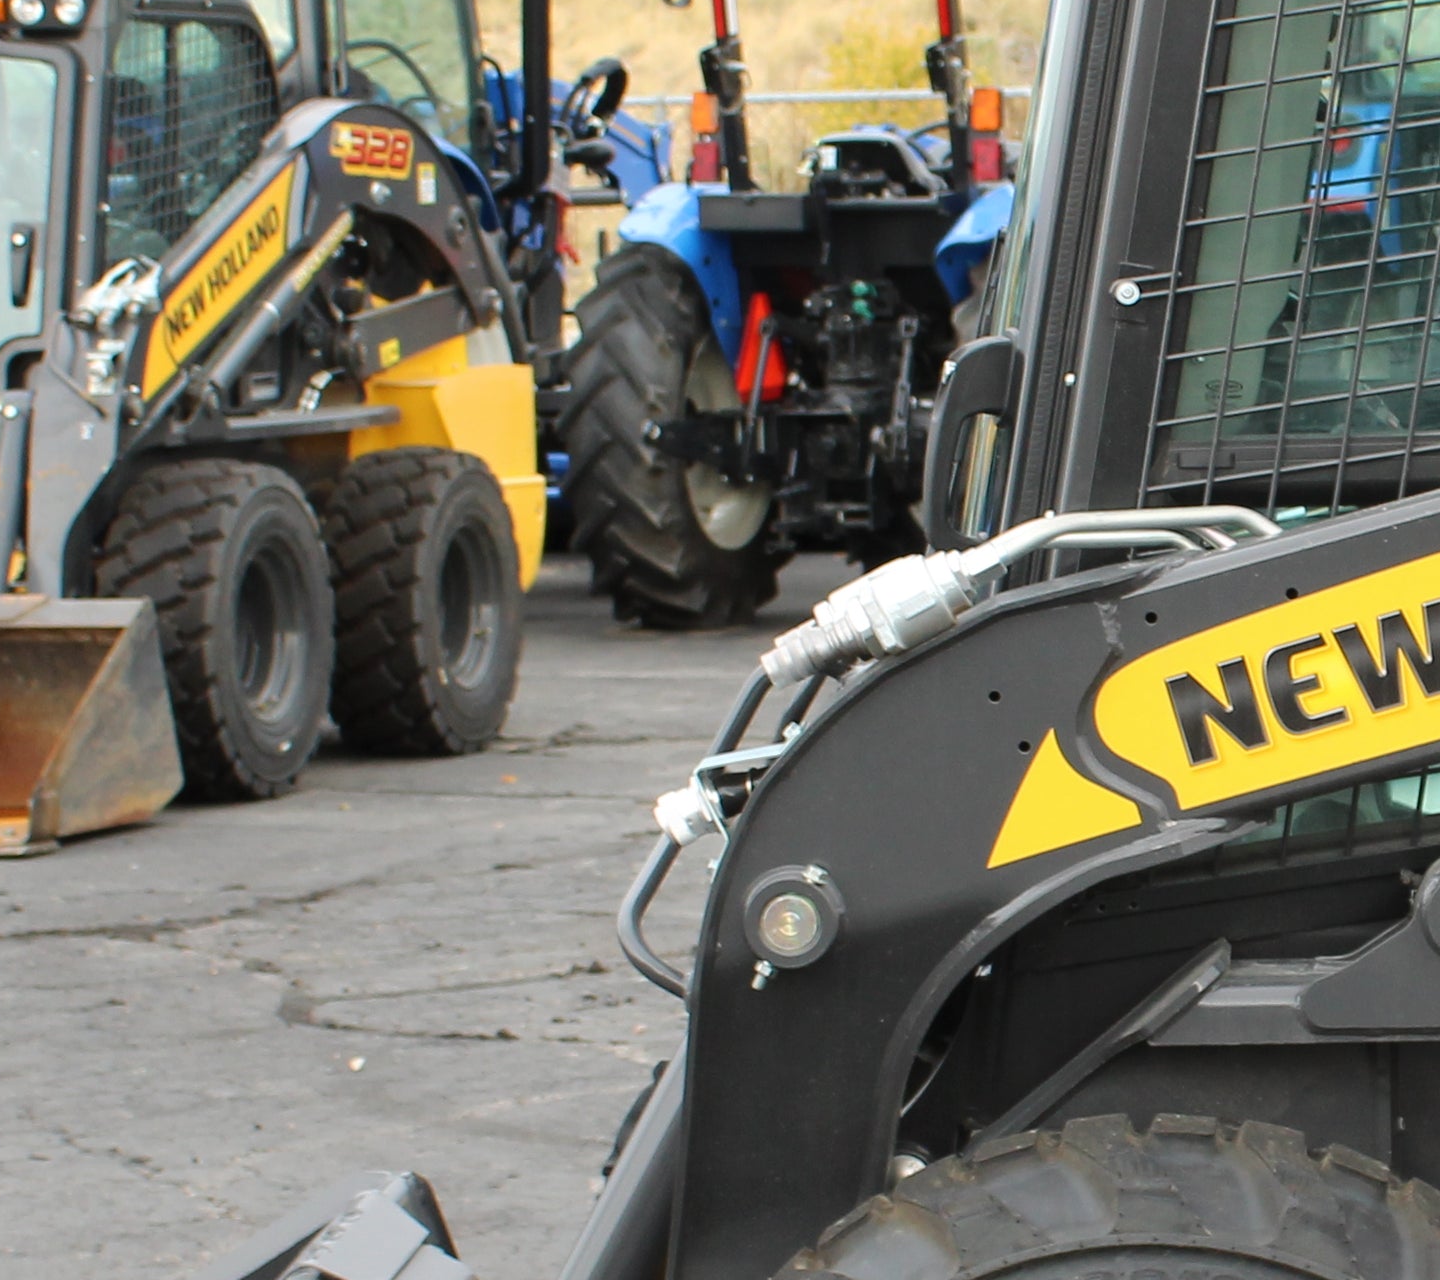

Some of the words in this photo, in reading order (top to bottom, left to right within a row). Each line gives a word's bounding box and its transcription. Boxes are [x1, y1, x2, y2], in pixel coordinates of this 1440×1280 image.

[332, 124, 412, 170] L328
[165, 277, 208, 343] NEW
[206, 204, 281, 303] HOLLAND
